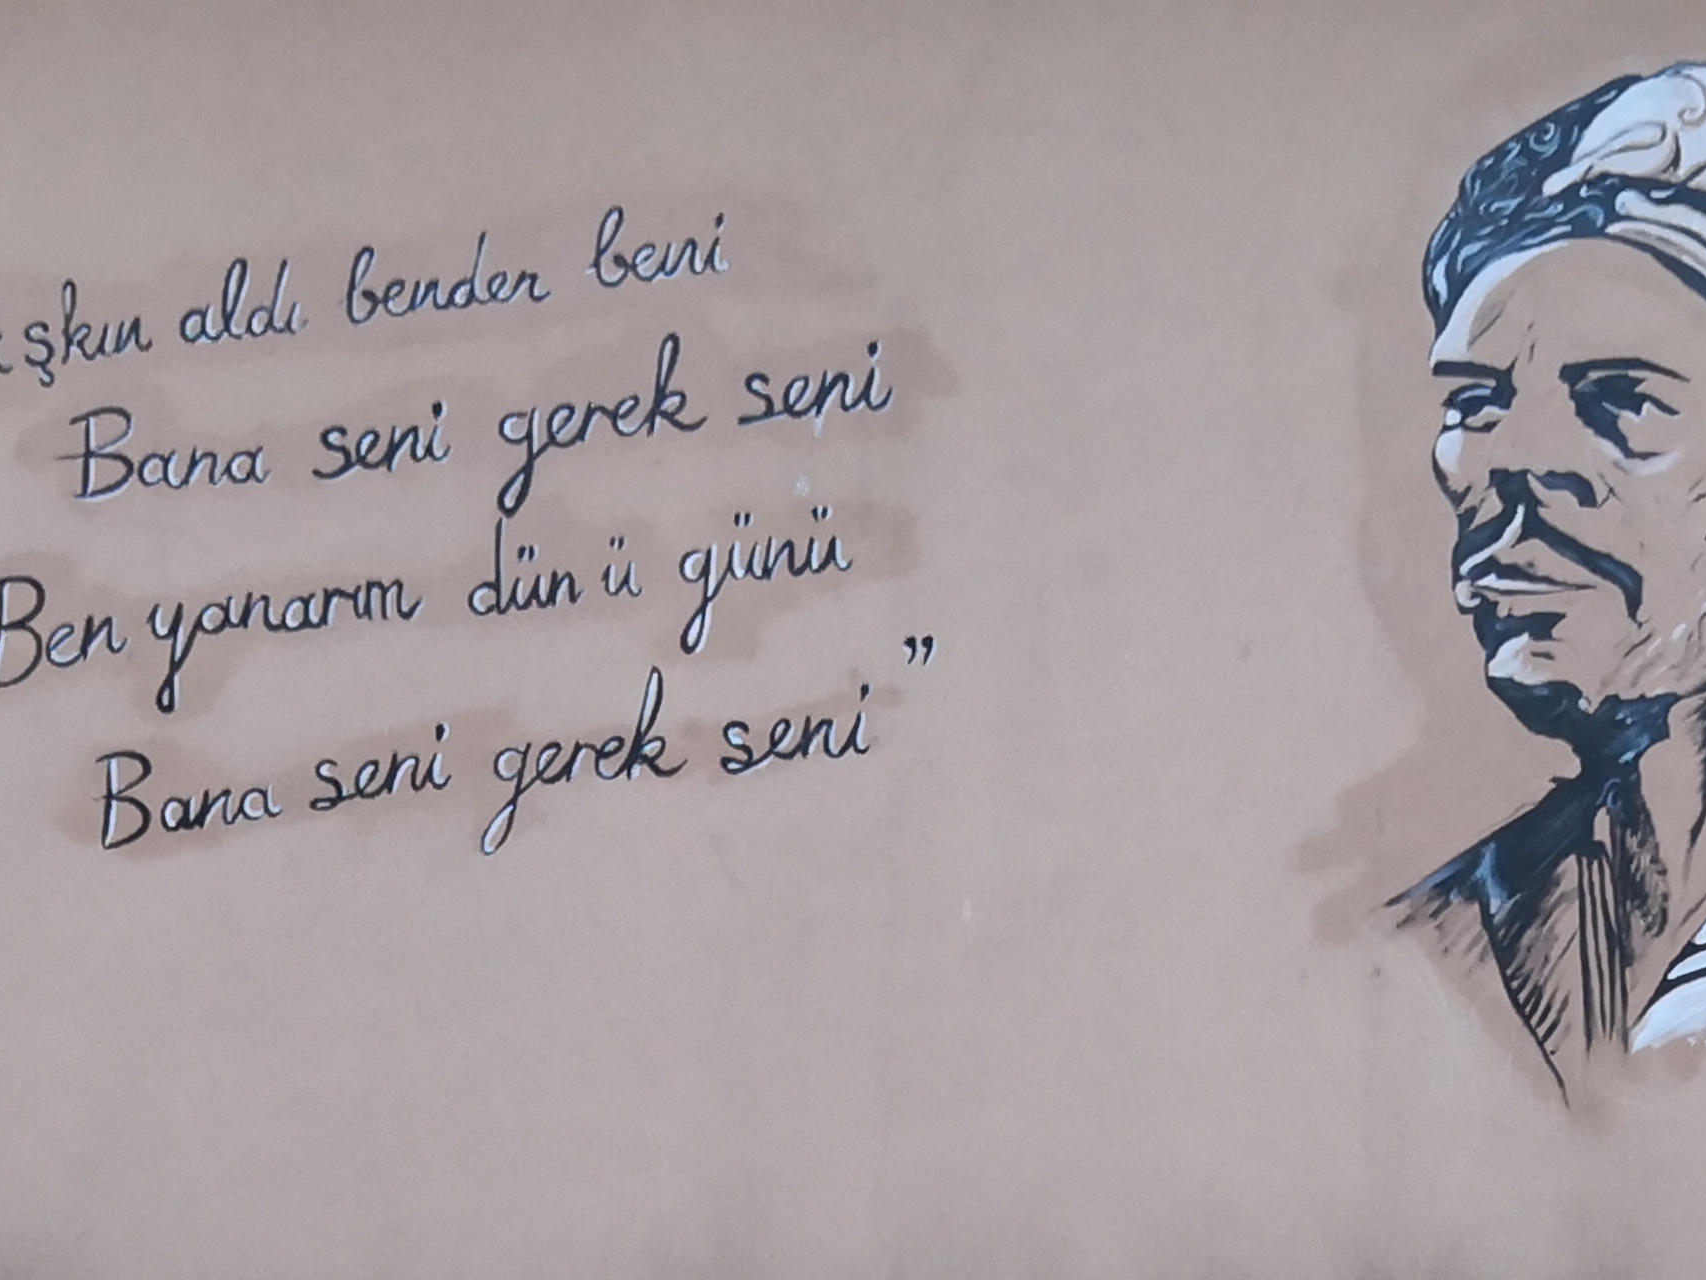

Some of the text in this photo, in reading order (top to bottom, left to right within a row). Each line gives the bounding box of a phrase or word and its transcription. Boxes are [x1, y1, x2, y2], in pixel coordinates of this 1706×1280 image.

[587, 204, 729, 290] beni
[57, 331, 895, 516] Bana seni gerek seni
[466, 517, 584, 618] dün
[600, 536, 643, 599] ü
[677, 506, 854, 657] günü
[94, 748, 284, 852] Bana
[307, 722, 453, 813] seni
[479, 664, 690, 857] gerek
